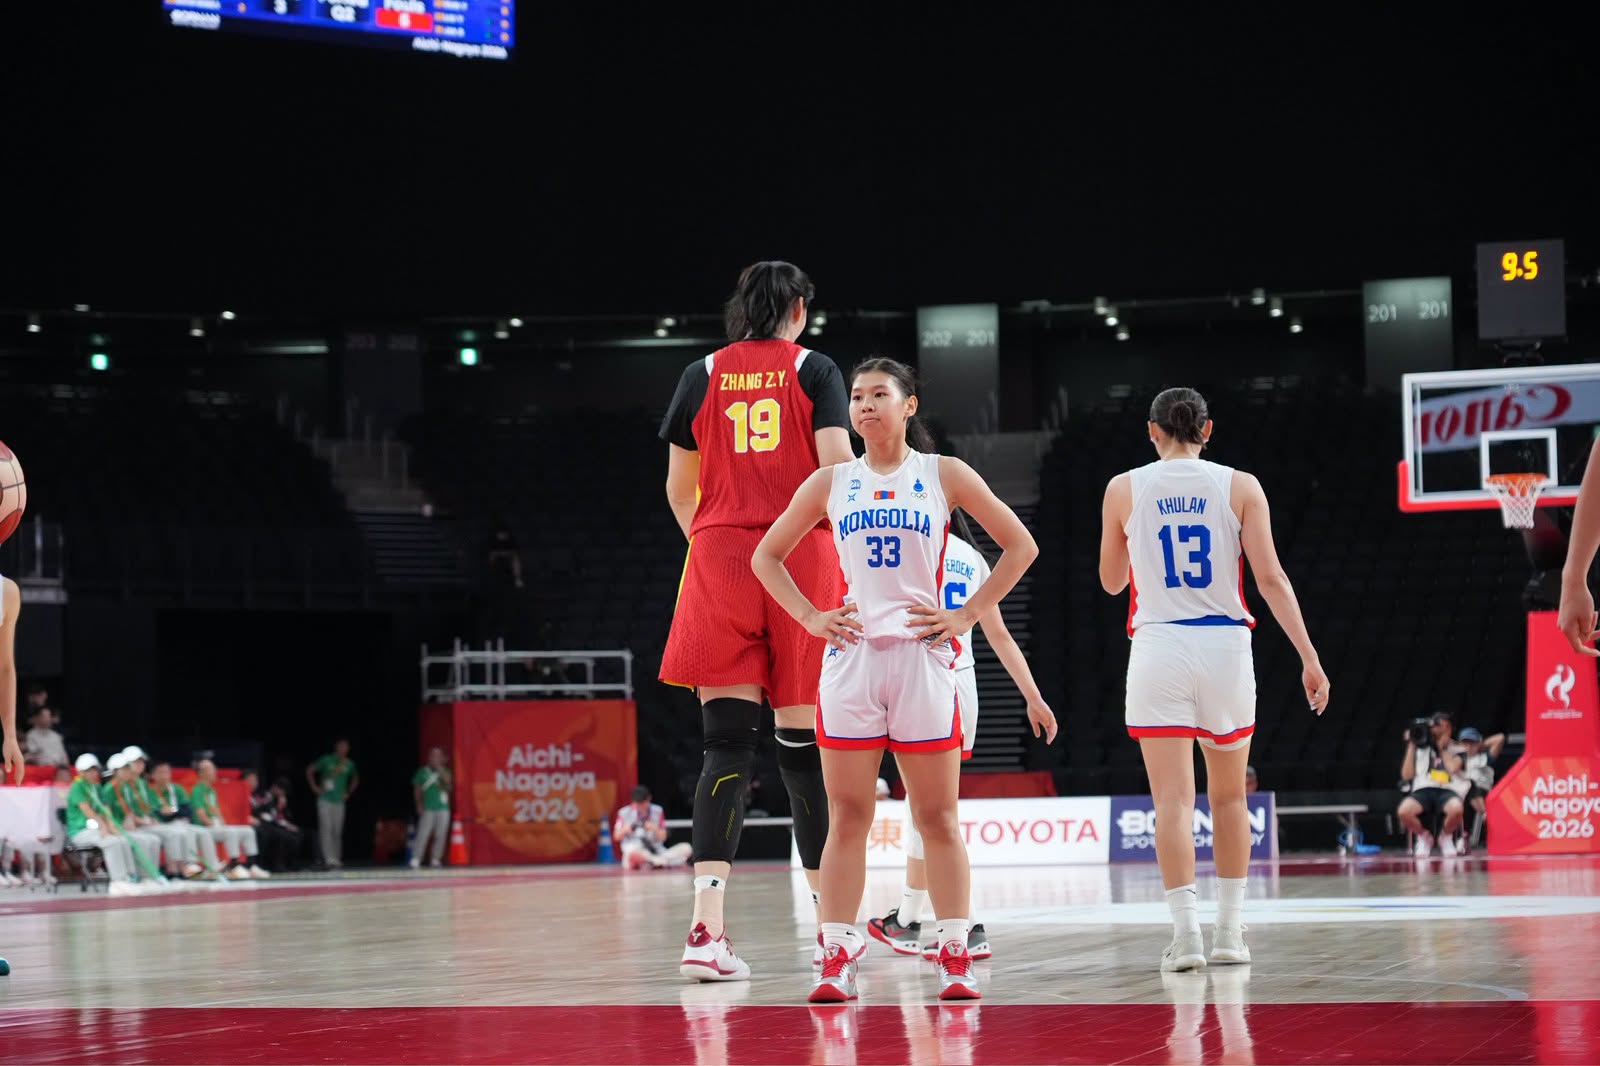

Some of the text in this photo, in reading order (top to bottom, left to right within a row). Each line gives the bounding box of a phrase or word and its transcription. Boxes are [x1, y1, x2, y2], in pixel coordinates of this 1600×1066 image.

[1502, 251, 1538, 281] 9.5
[1367, 300, 1448, 323] 201 201
[720, 372, 763, 391] ZHANG
[724, 398, 780, 453] 19
[1157, 496, 1207, 515] KHULAN
[838, 508, 931, 541] MONGOLIA
[866, 535, 902, 568] 33
[1158, 524, 1213, 589] 13
[506, 743, 585, 769] Aichi-
[495, 769, 597, 797] Nagoya
[1532, 772, 1600, 796] Aichi-
[513, 798, 579, 823] 2026
[869, 817, 902, 851] 東
[960, 819, 1100, 845] TOYOTA
[1537, 818, 1595, 839] 2026
